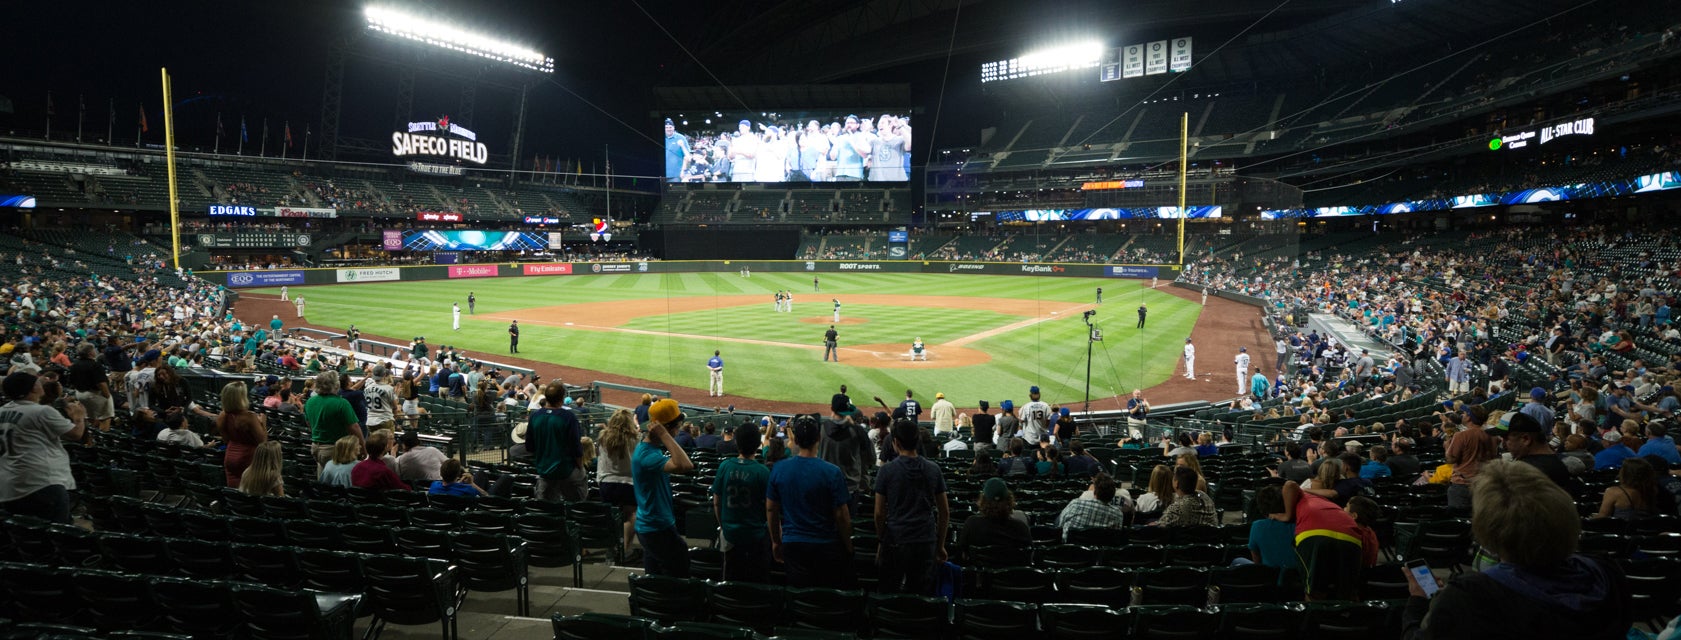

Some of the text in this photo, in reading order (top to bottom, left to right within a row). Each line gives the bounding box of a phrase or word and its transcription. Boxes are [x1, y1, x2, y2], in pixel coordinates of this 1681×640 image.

[1574, 118, 1594, 134] CLUB
[392, 131, 488, 164] SAFECO FIELD
[366, 396, 382, 409] 29
[906, 406, 916, 415] 51
[1032, 410, 1043, 420] 13
